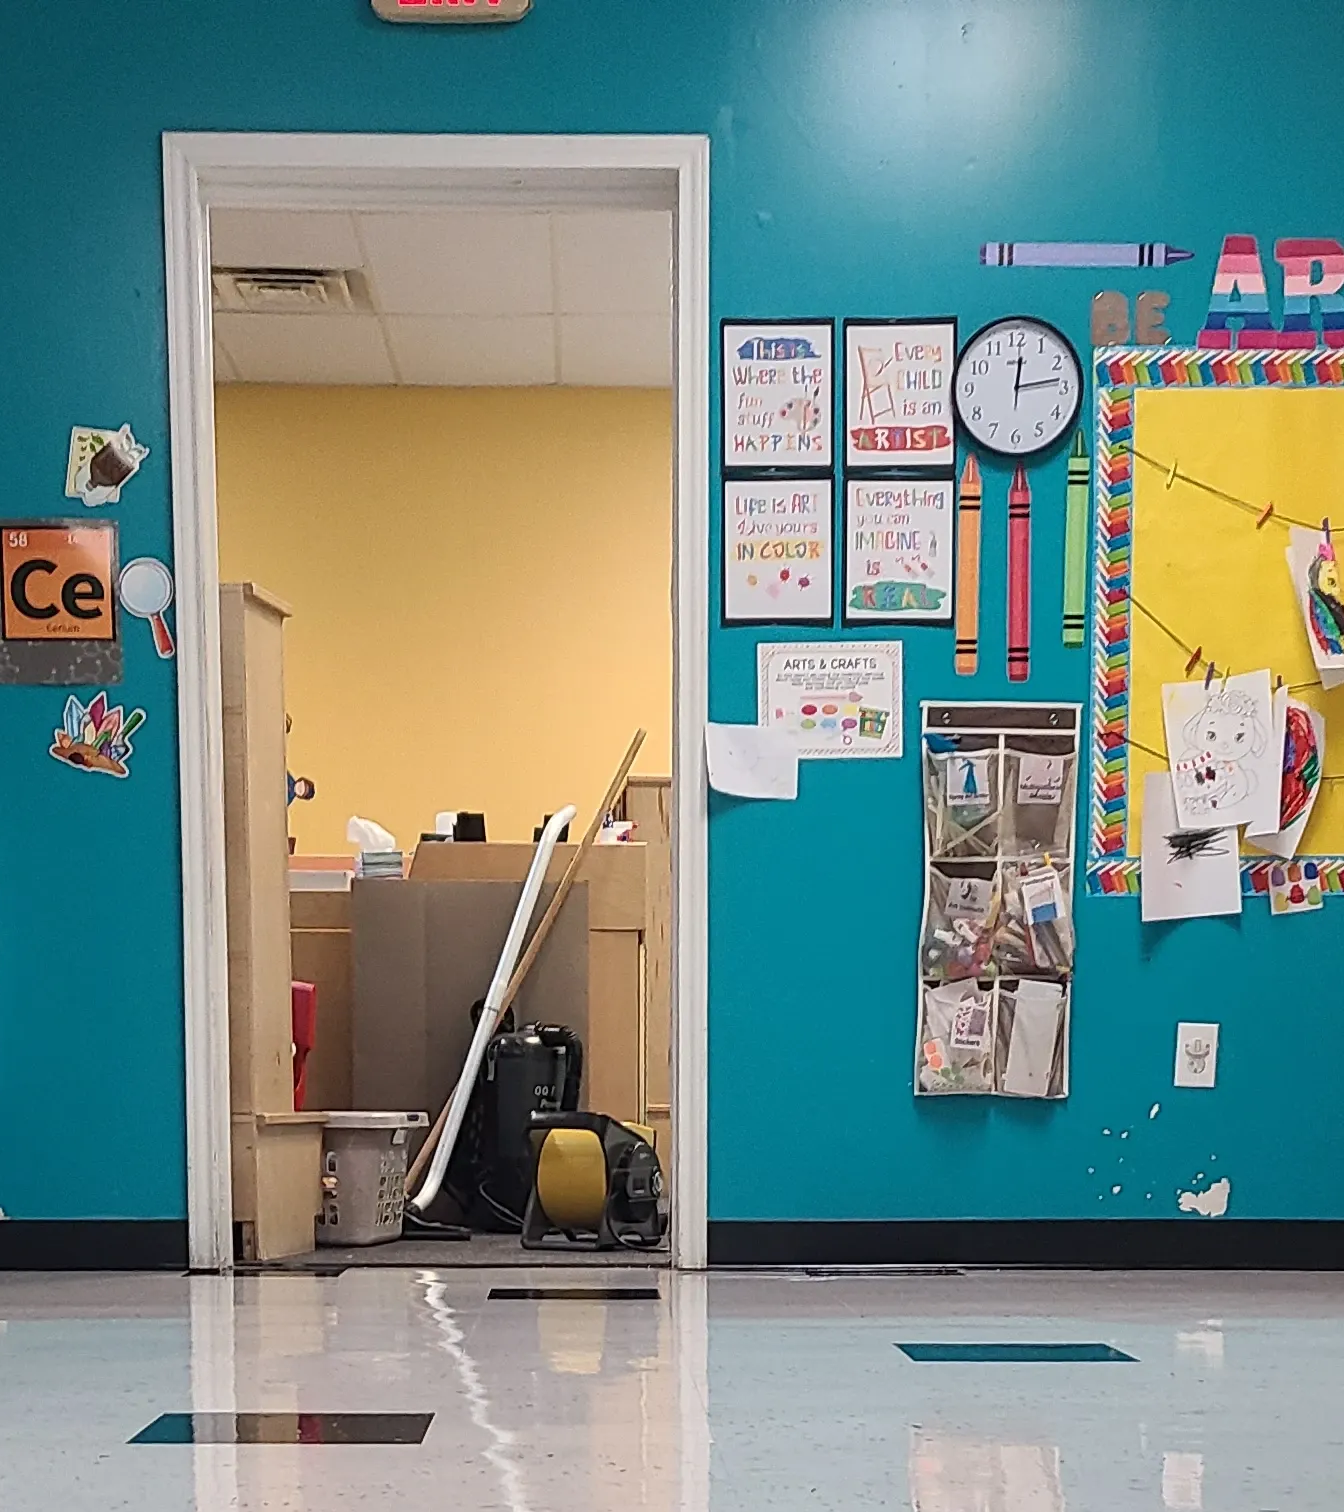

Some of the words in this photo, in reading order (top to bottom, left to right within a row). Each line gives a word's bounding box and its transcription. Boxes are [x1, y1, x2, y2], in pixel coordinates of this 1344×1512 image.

[1090, 290, 1171, 347] BE
[1009, 332, 1027, 347] 12
[987, 341, 1001, 356] 11
[972, 360, 989, 375] 10
[1052, 355, 1063, 371] 2
[792, 365, 822, 385] the
[964, 382, 975, 398] 9
[1058, 380, 1069, 395] 3
[903, 401, 917, 417] is
[922, 401, 942, 417] an
[971, 406, 982, 421] 8
[1050, 404, 1061, 421] 4
[988, 422, 999, 439] 7
[1010, 429, 1021, 444] 6
[1034, 421, 1044, 437] 5
[859, 428, 942, 449] ARTIST
[737, 541, 754, 560] IN
[760, 541, 821, 559] COLOR
[783, 658, 815, 670] ARTS
[830, 658, 877, 669] CRAFTS
